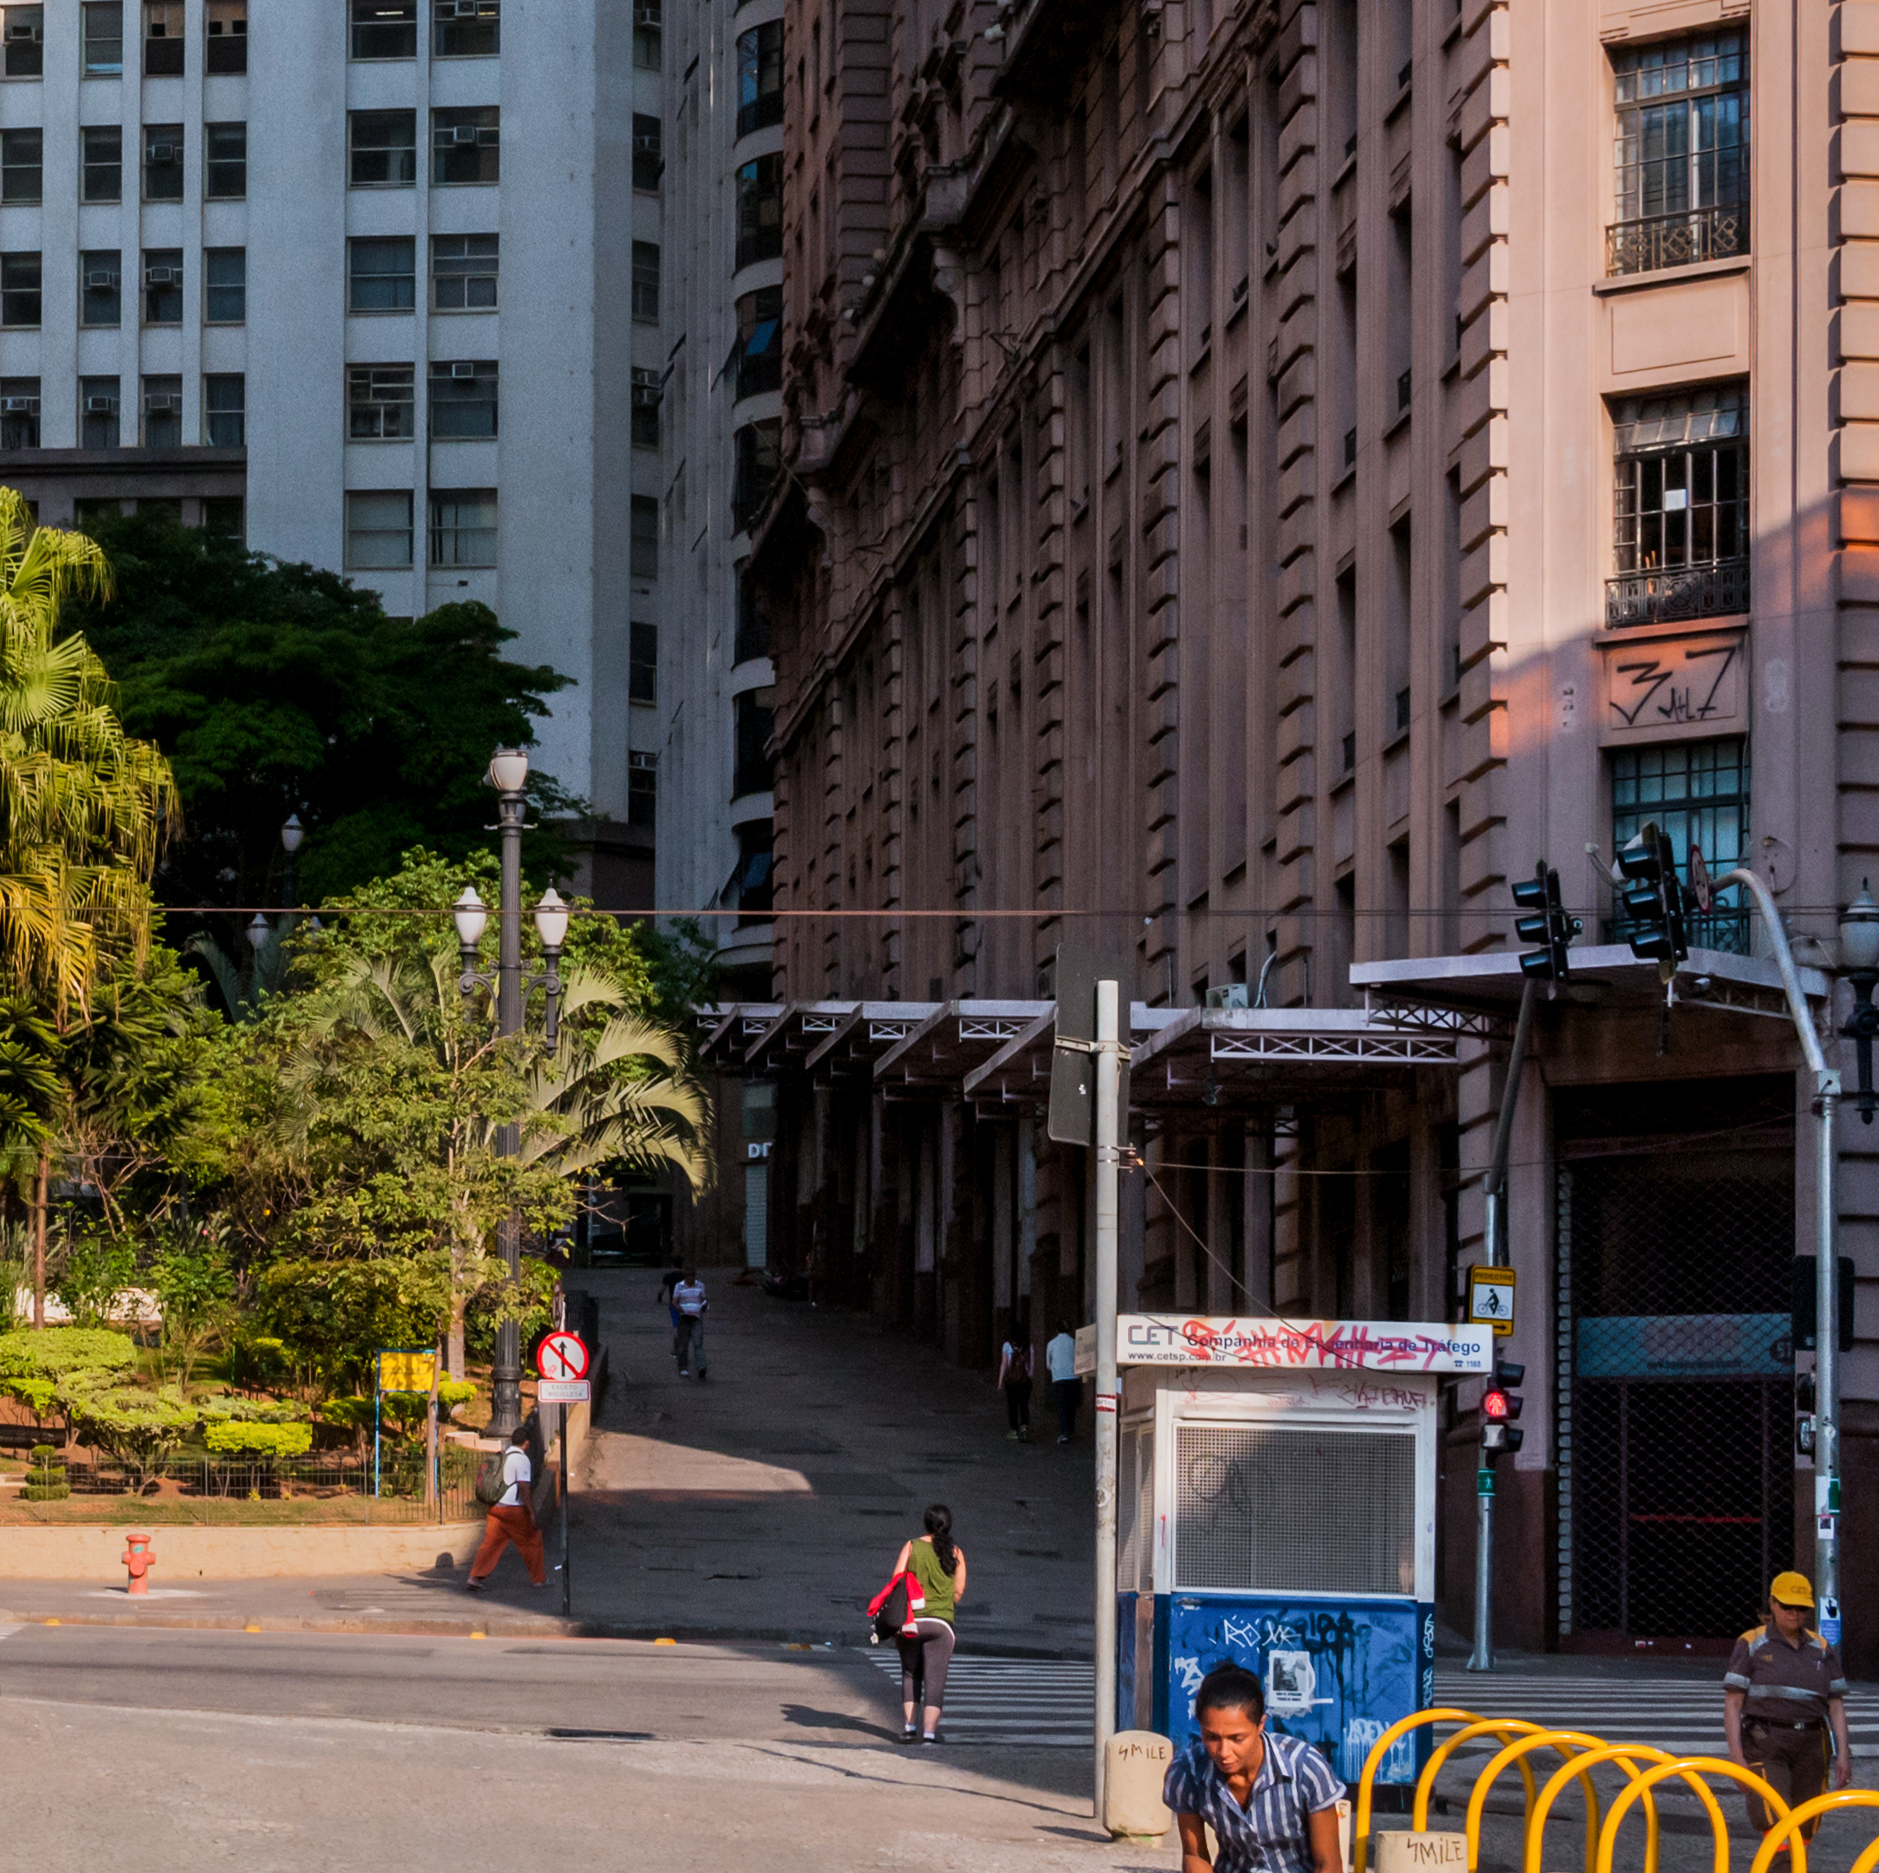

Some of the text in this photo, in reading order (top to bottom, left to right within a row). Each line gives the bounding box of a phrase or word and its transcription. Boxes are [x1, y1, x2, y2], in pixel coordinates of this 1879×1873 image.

[1474, 1272, 1513, 1282] PEDESTRE
[1127, 1325, 1179, 1346] CET
[1187, 1333, 1278, 1350] Companhia
[1398, 1339, 1417, 1353] de
[1424, 1338, 1481, 1356] Tráfego
